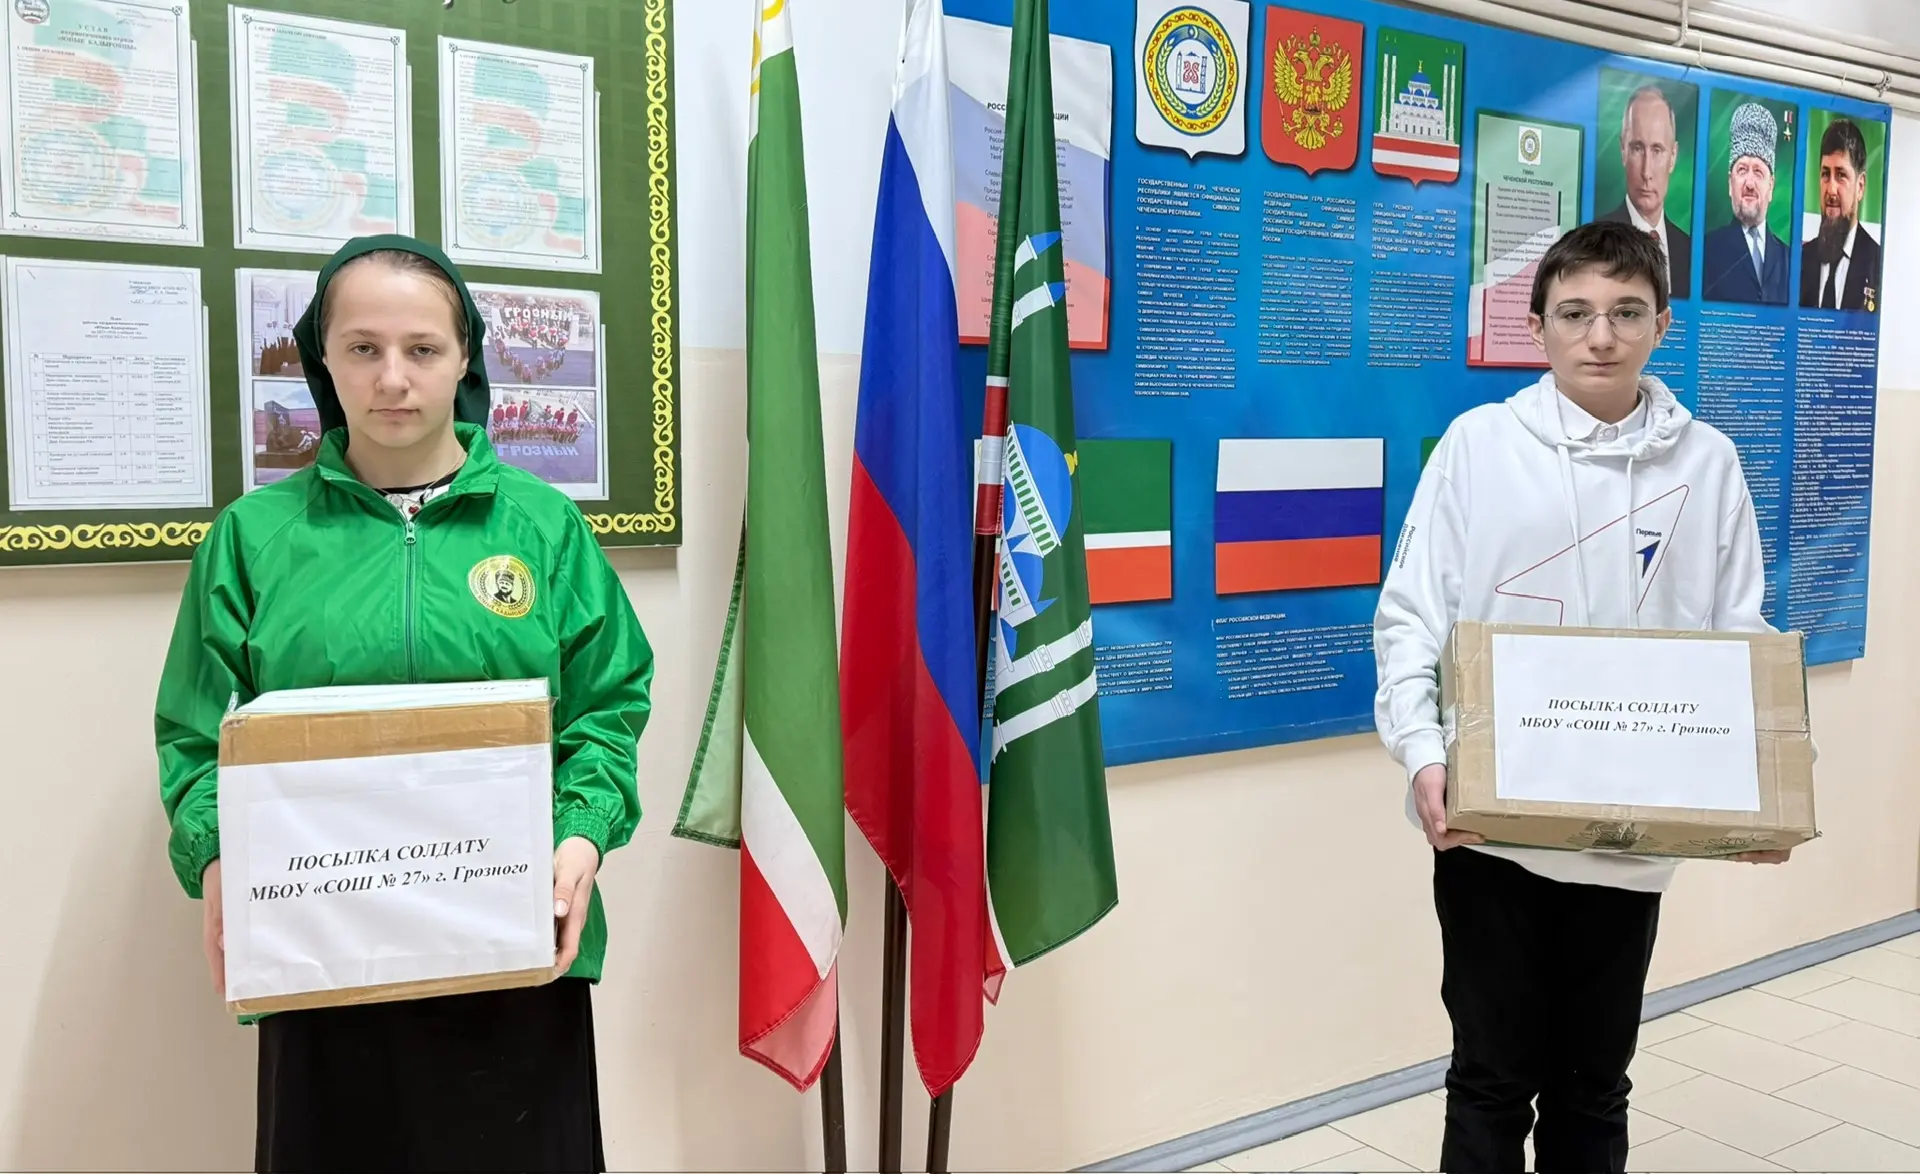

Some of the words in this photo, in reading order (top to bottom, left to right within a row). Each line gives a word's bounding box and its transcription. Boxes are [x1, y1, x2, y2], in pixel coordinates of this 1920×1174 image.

[1548, 699, 1623, 713] ПОСЫЛКА
[1628, 701, 1699, 714] СОЛДАТУ
[1519, 716, 1563, 729] МБОУ
[1566, 719, 1611, 731] «СОШ
[1613, 721, 1628, 732] №
[1631, 721, 1654, 733] 27»
[1657, 725, 1666, 733] г.
[1671, 722, 1731, 736] Грозного
[288, 848, 390, 872] ПОСЫЛКА
[397, 838, 490, 860] СОЛДАТУ
[249, 882, 308, 902] МБОУ
[313, 876, 373, 896] «СОШ
[378, 873, 397, 889] №
[402, 870, 430, 886] 27»
[435, 871, 447, 883] г.
[453, 862, 529, 884] Грозного
